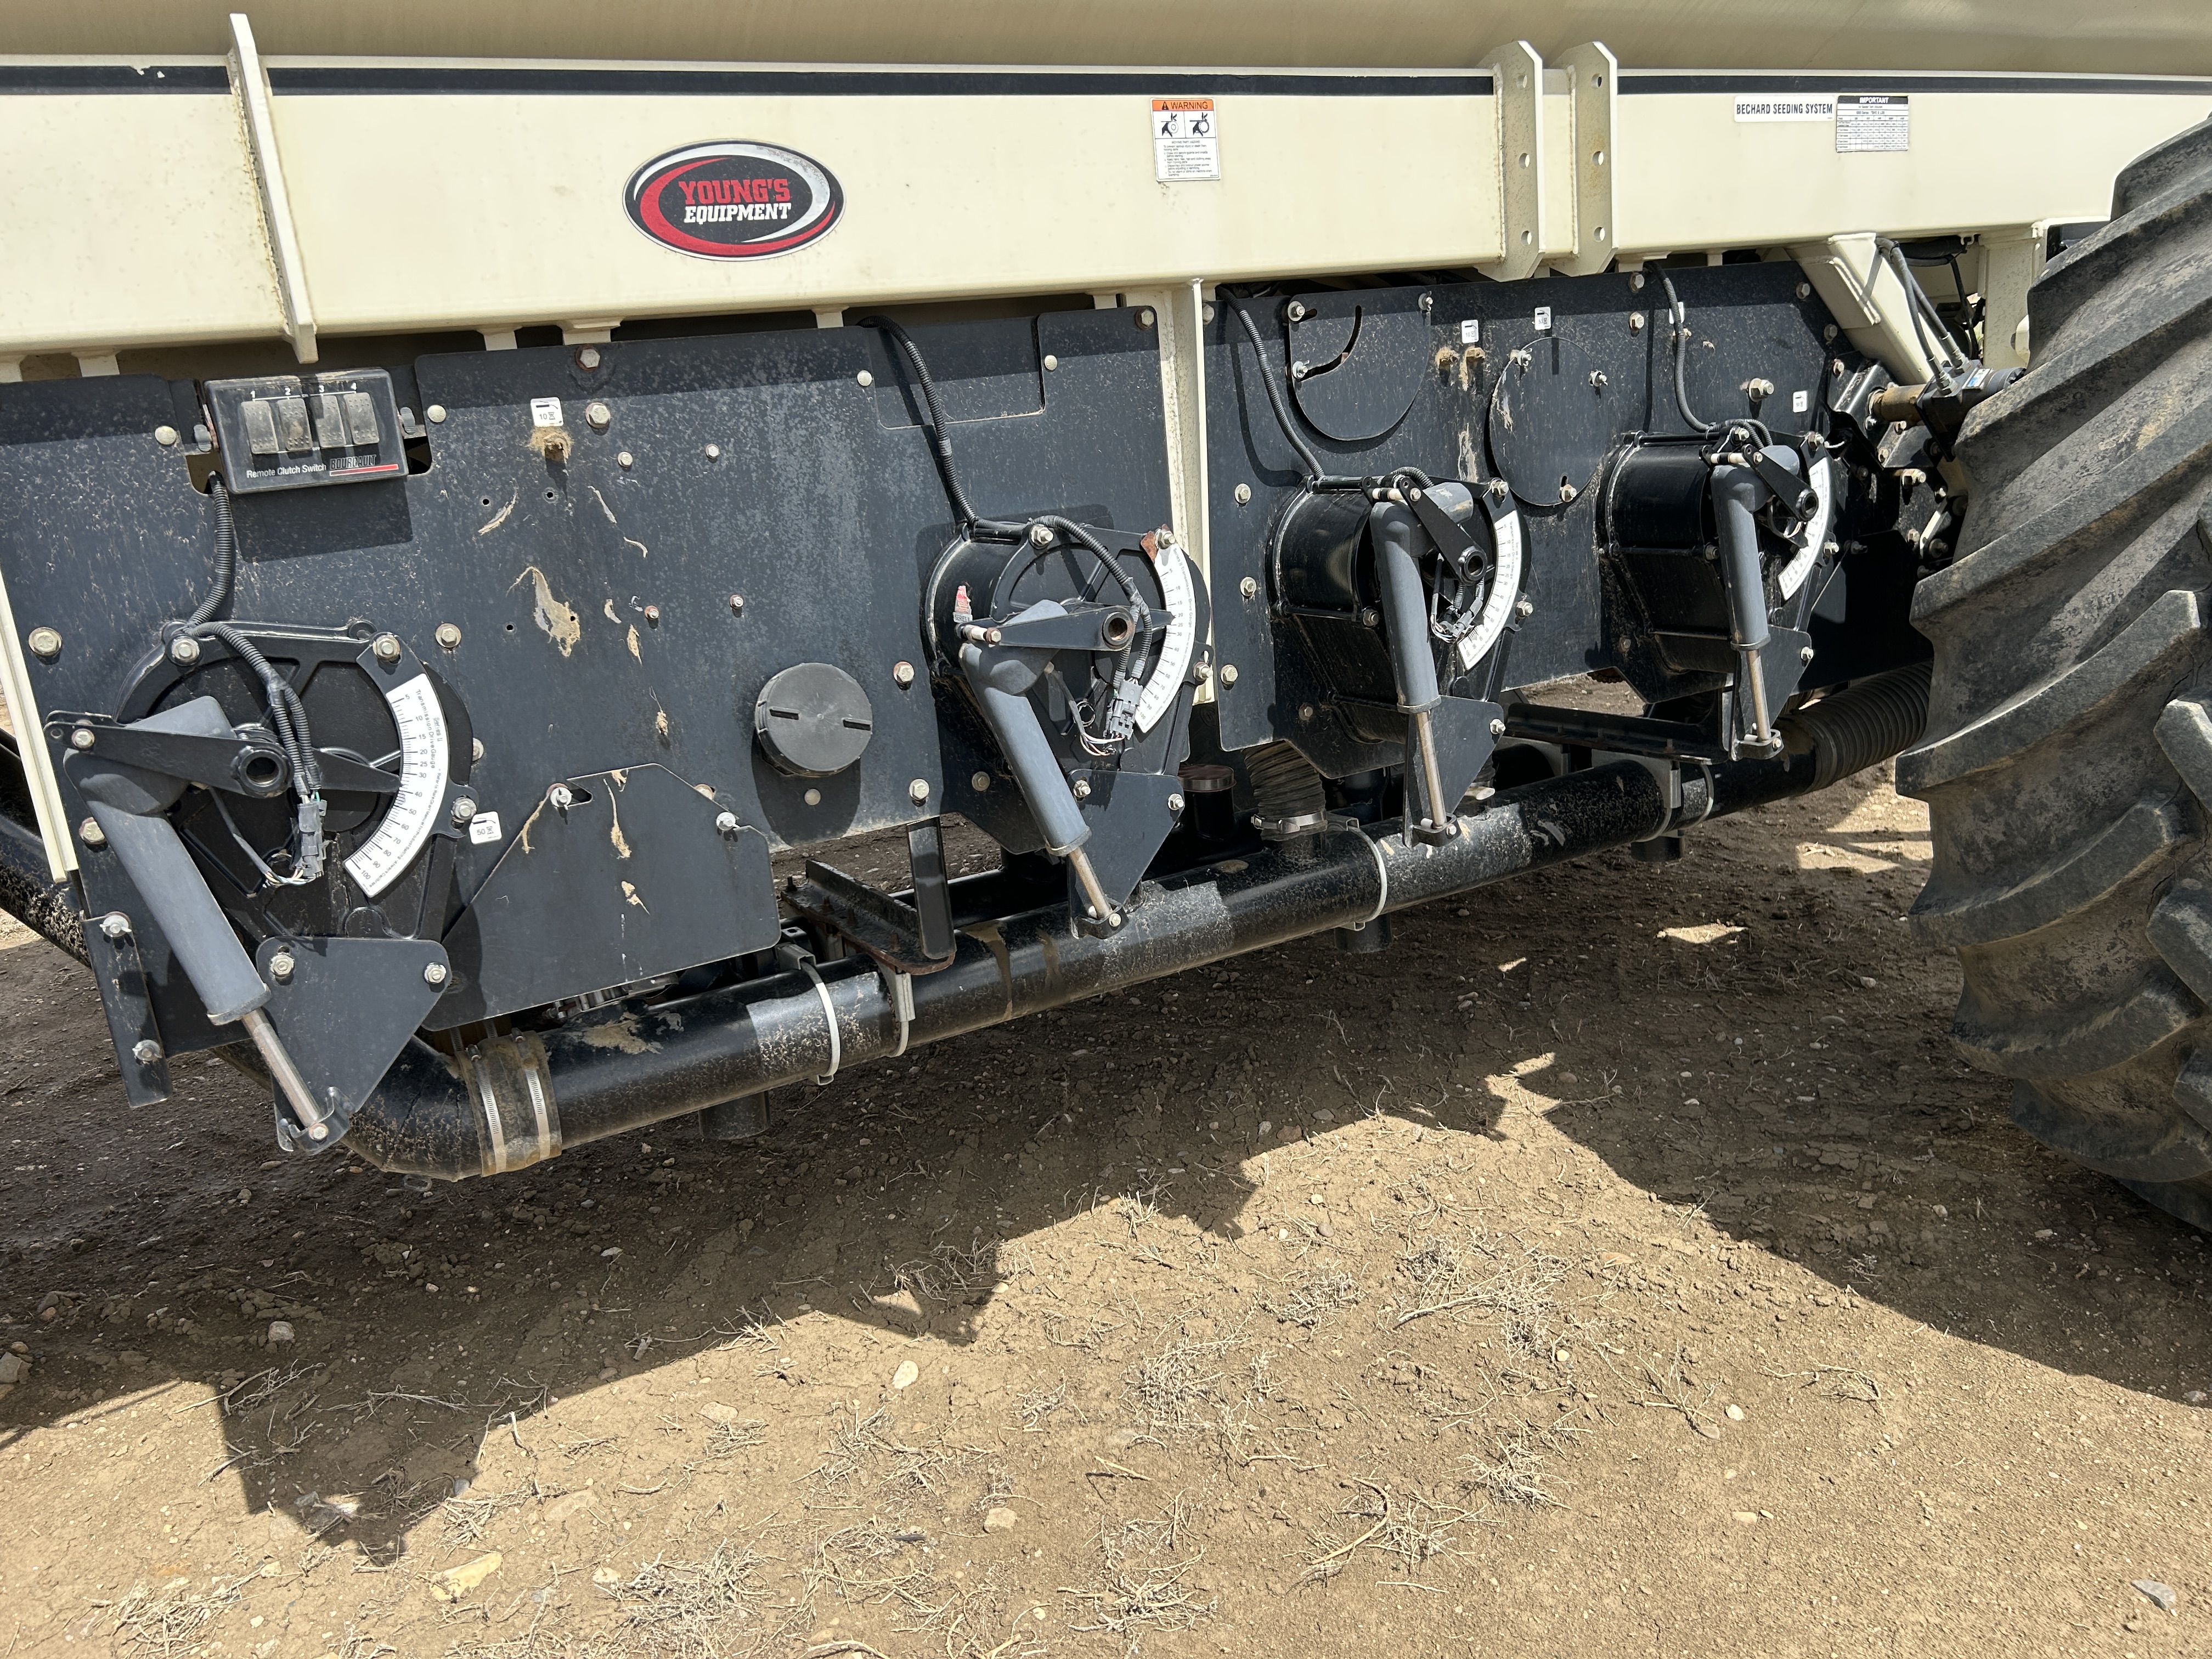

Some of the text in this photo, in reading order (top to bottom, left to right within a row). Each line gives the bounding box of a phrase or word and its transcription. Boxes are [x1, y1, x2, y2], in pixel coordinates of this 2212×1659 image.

[1171, 101, 1208, 110] WARNING
[1736, 103, 1833, 115] BECHARD SEEDING SYSTEM
[678, 178, 791, 205] YOUNG'S
[684, 202, 791, 224] EQUIPMENT
[250, 390, 256, 398] 1
[285, 387, 291, 396] 2
[319, 385, 325, 393] 3
[330, 454, 377, 470] BOURGAULT
[246, 463, 327, 478] Remote Clutch Switch
[1181, 566, 1190, 598] Transmission
[415, 689, 432, 731] Transmission
[433, 717, 442, 736] Series
[361, 870, 371, 880] 100
